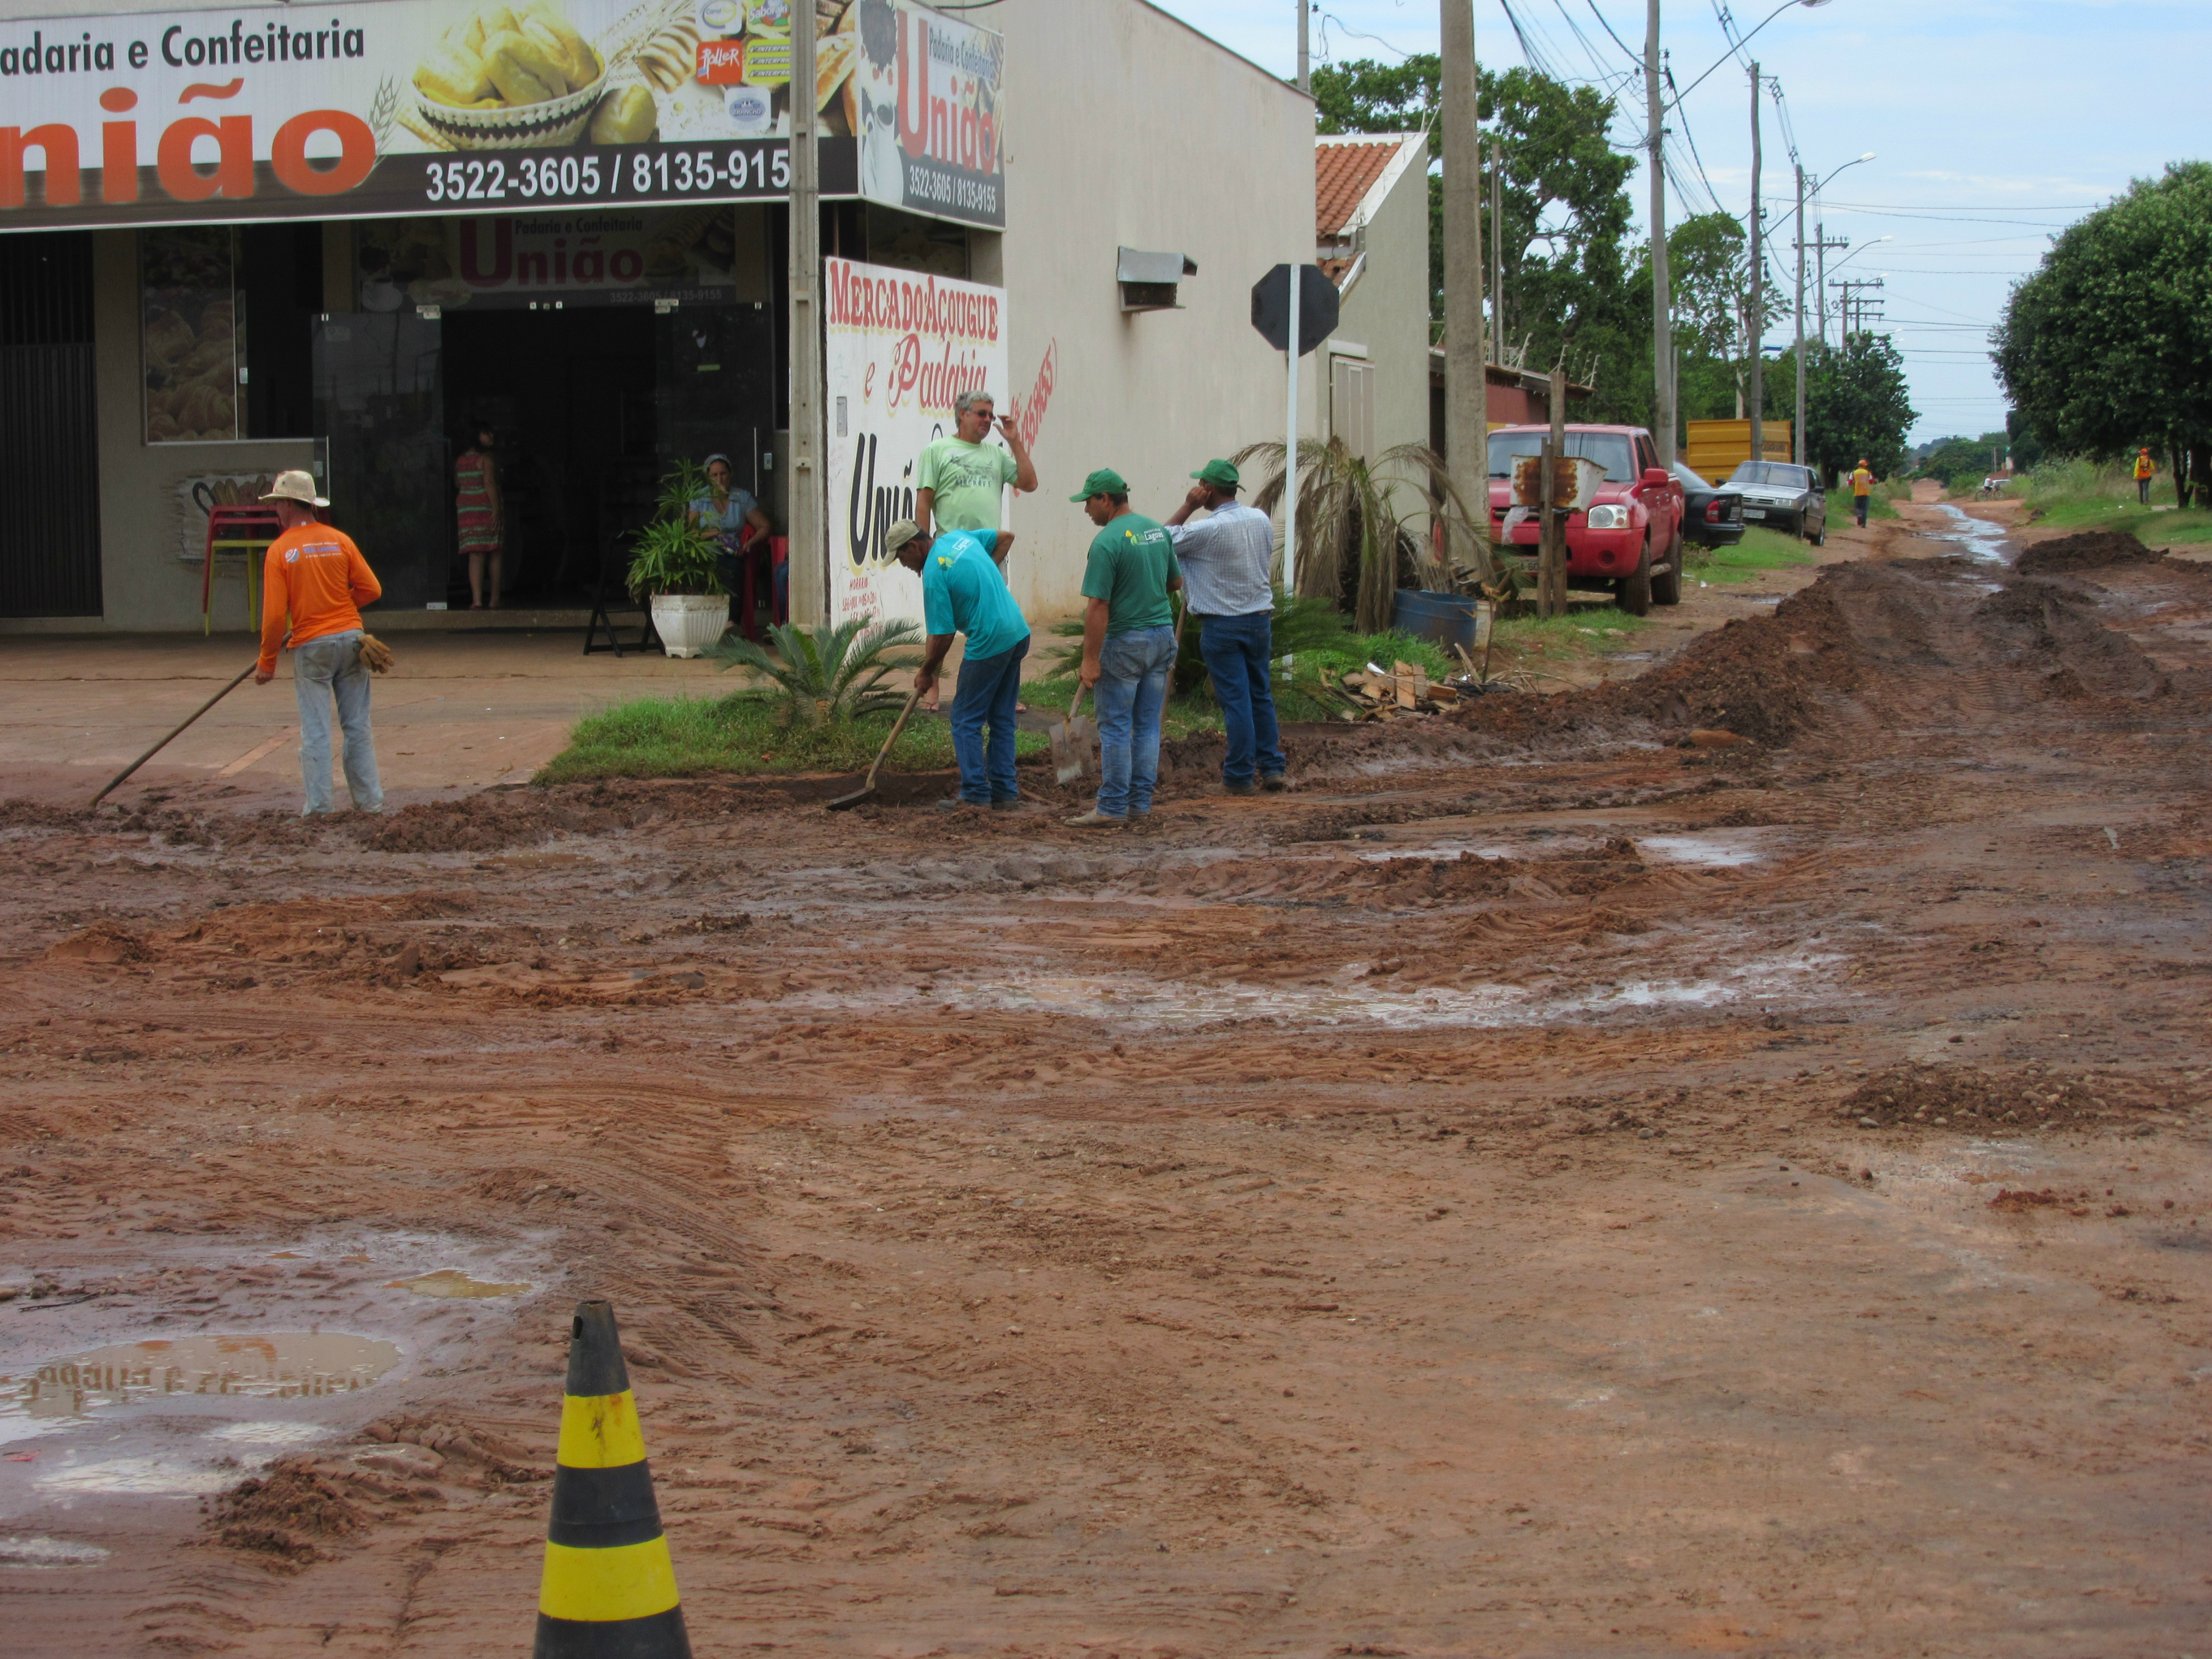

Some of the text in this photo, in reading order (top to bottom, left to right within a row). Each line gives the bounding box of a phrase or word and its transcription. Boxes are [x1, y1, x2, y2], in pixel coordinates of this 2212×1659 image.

[129, 41, 149, 70] e
[162, 19, 365, 67] Confeitaria
[929, 28, 996, 79] Padaria e Confeitaria
[896, 9, 995, 177] União
[426, 155, 600, 201] 3522-3605
[611, 154, 621, 193] /
[910, 165, 996, 214] 3522-3605 / 8135-9155
[515, 216, 643, 234] Padaria e Confeitaria
[460, 218, 643, 287] União
[865, 362, 875, 398] e
[888, 333, 987, 410] Padaria
[1144, 532, 1164, 540] Lagoas
